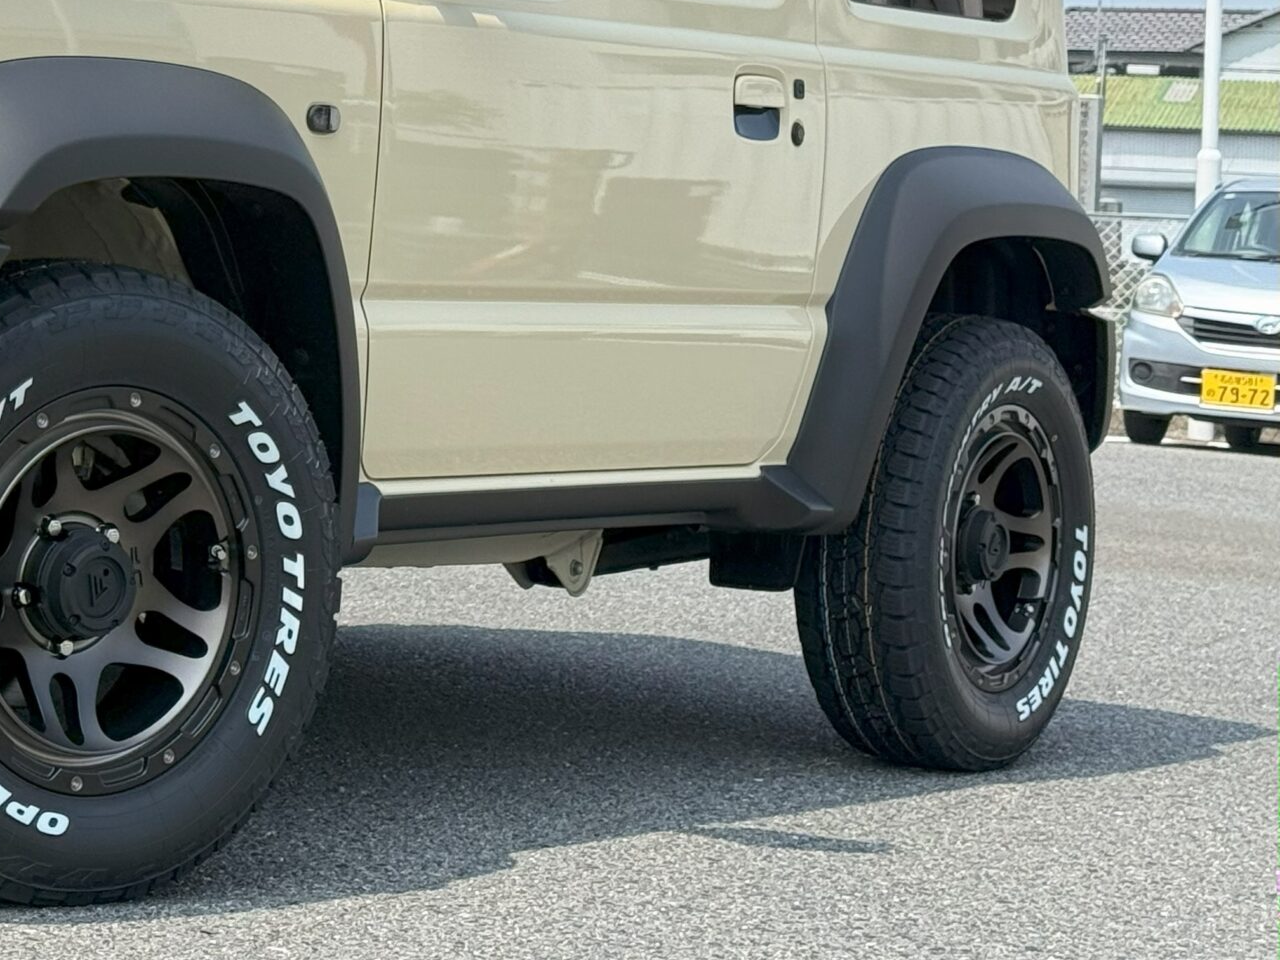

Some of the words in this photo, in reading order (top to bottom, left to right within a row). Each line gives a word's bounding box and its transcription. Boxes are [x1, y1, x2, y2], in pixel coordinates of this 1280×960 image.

[1004, 376, 1043, 394] A/T
[1218, 386, 1270, 407] 79-72
[229, 401, 304, 540] TOYO
[1063, 525, 1088, 638] TOYO
[248, 553, 305, 736] TIRES
[1016, 640, 1069, 721] TIRES
